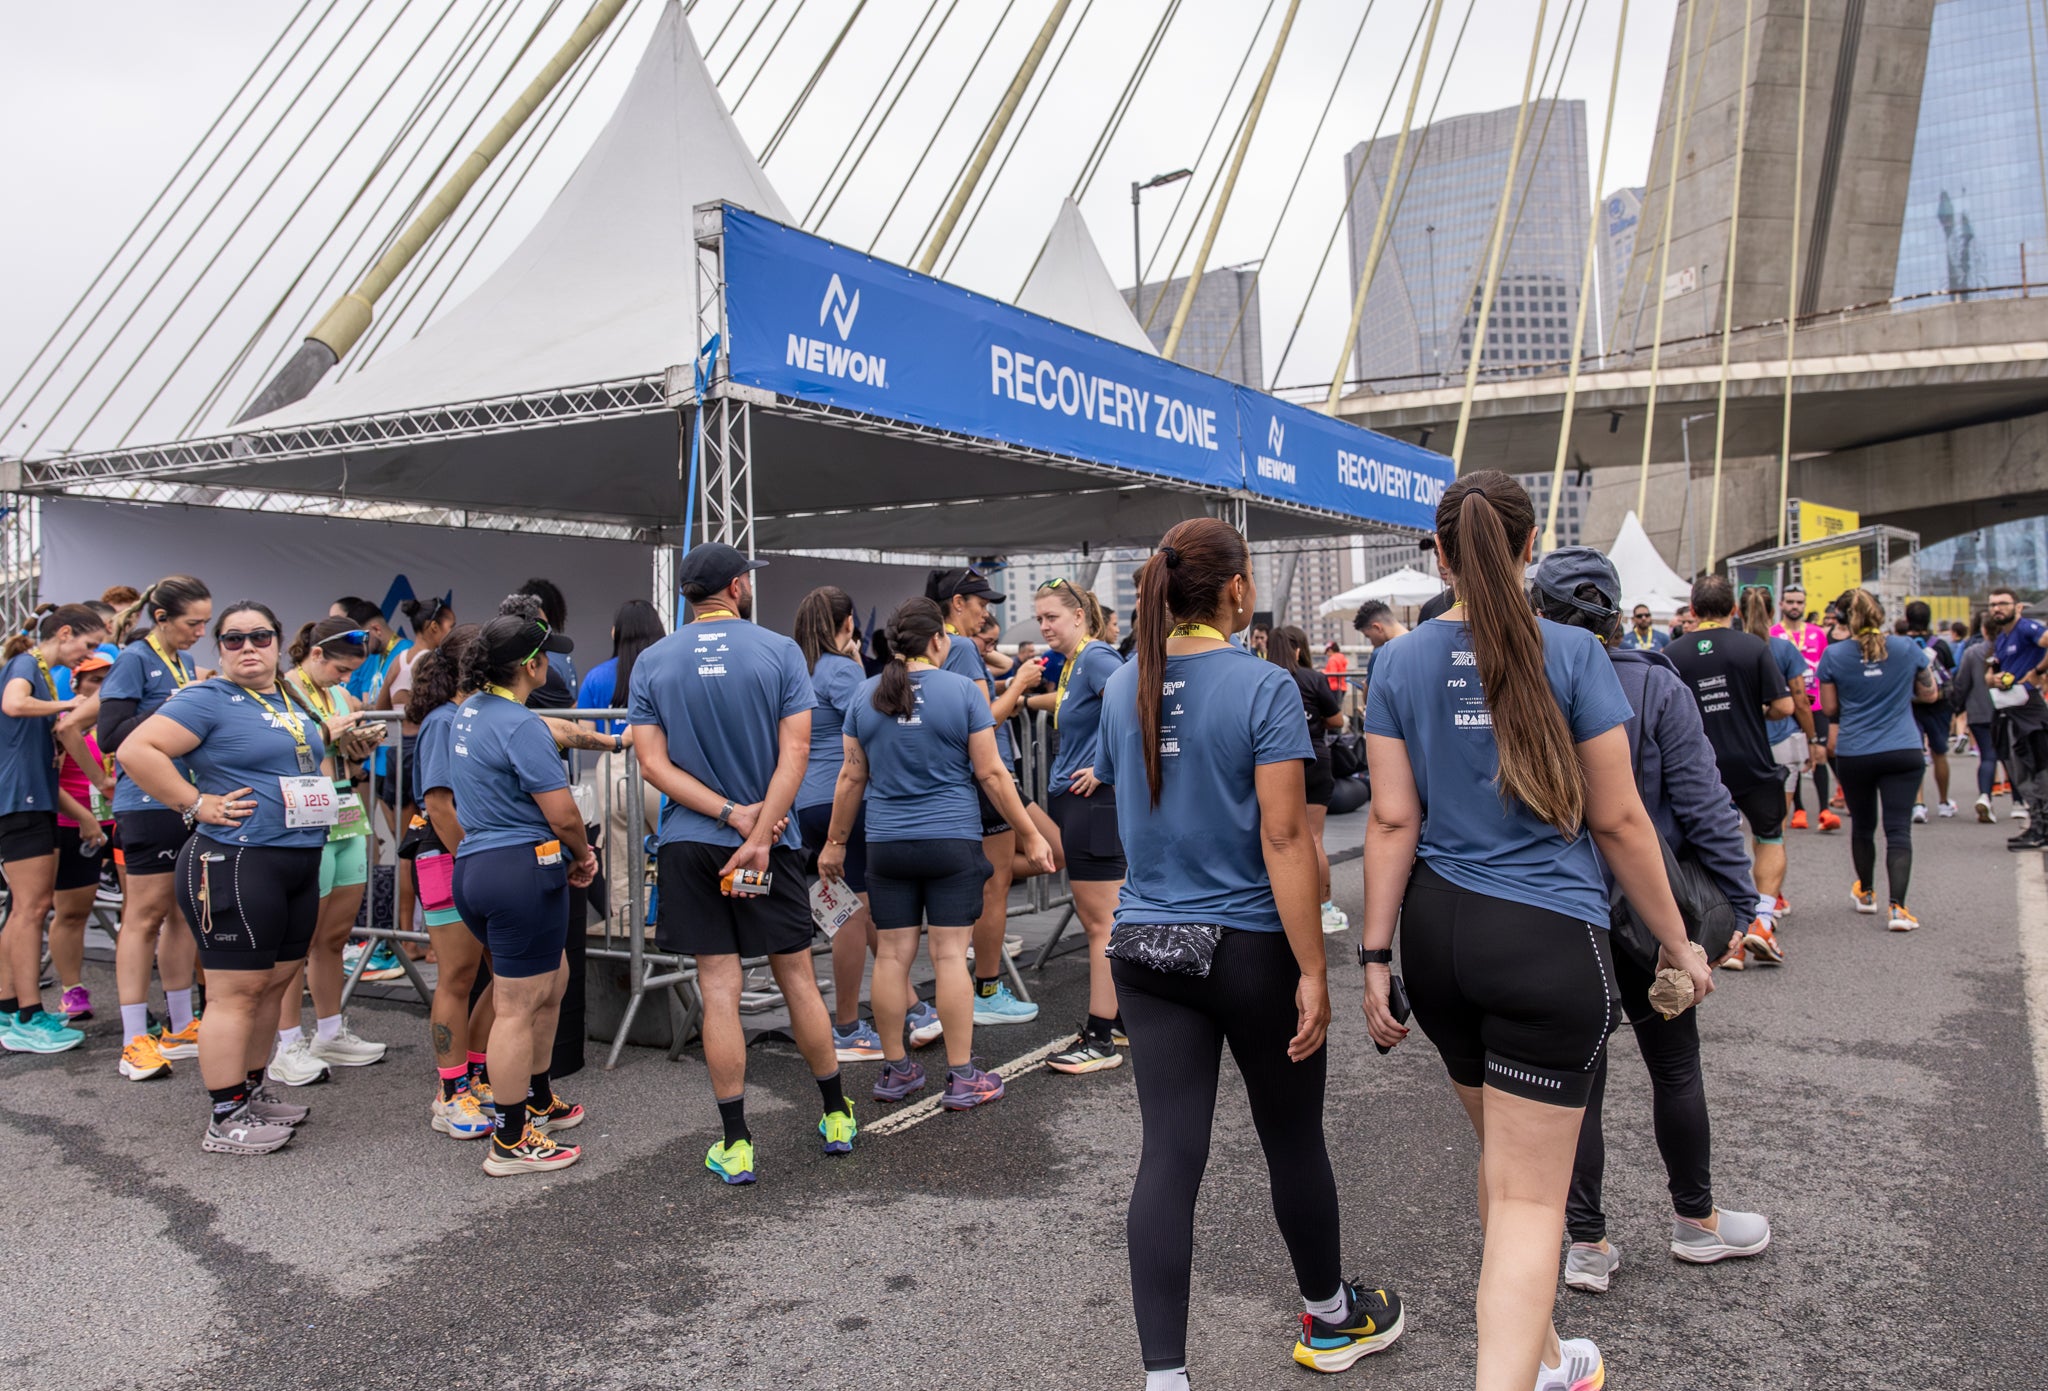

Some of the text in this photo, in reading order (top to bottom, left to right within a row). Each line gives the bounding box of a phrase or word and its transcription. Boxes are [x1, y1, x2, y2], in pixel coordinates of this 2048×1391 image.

[786, 333, 887, 388] NEWON
[991, 344, 1218, 450] RECOVERY ZONE
[1257, 455, 1297, 485] NEWON
[1337, 450, 1446, 507] RECOVERY ZONE
[1163, 687, 1175, 696] UN
[1447, 678, 1467, 687] rvb
[303, 793, 330, 807] 1215
[817, 889, 838, 911] 544
